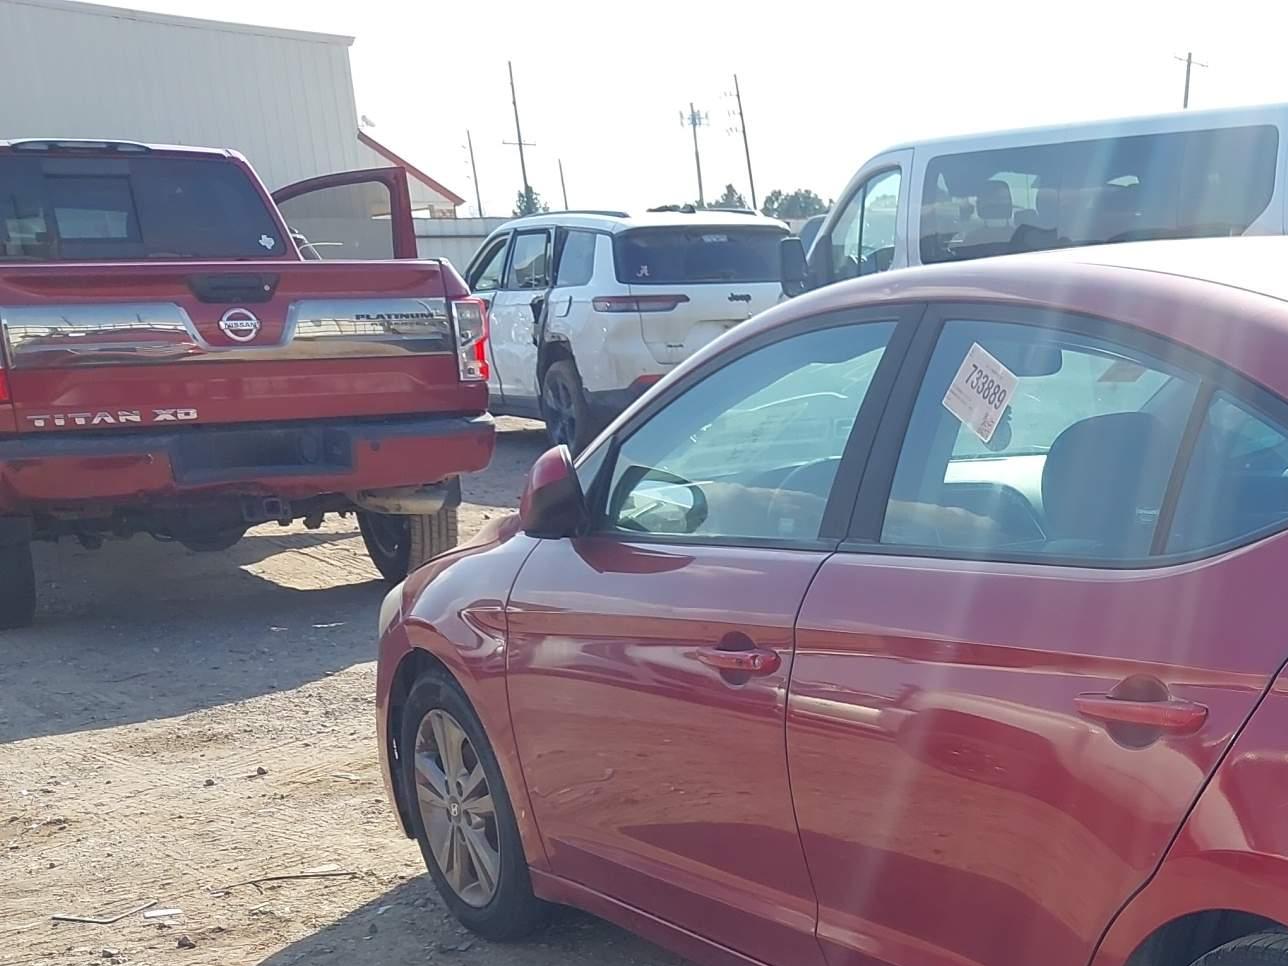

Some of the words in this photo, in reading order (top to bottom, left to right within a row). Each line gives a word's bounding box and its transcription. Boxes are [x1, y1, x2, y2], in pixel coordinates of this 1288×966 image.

[355, 312, 435, 321] PLATINUM
[224, 321, 257, 330] NISSAN
[965, 363, 1007, 410] 733889
[26, 410, 142, 427] TITAN
[151, 408, 199, 422] XD
